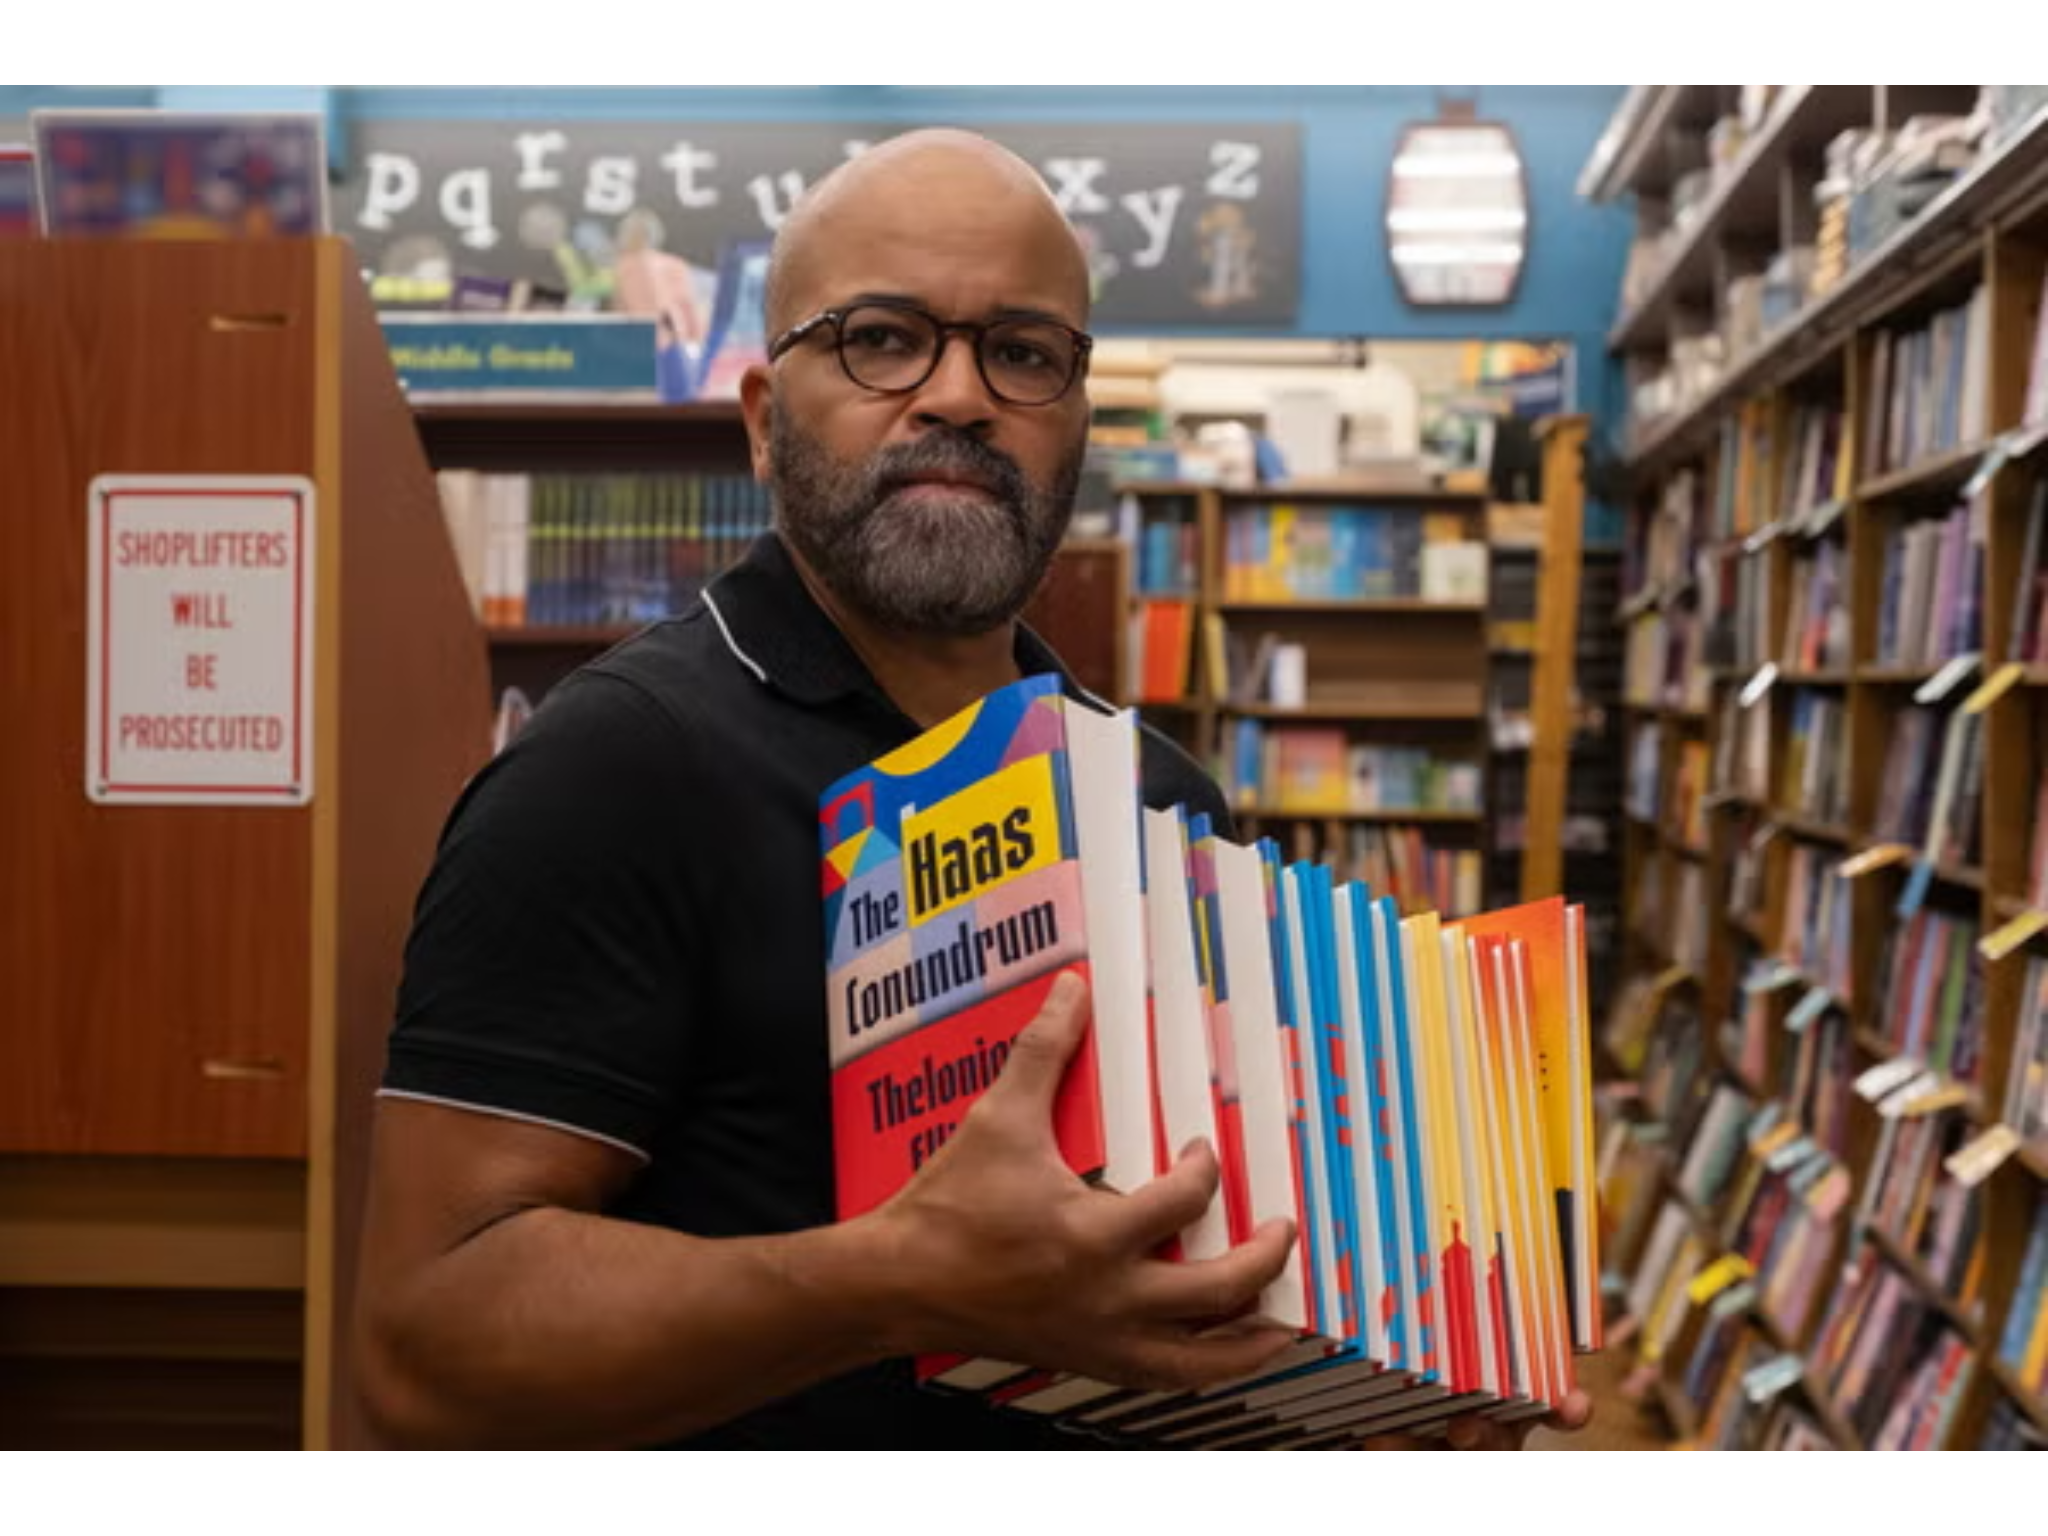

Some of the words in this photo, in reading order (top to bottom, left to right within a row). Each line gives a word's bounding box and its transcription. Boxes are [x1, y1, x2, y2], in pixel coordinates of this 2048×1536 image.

[357, 152, 420, 231] p
[439, 166, 499, 250] q
[513, 130, 567, 190] r
[583, 156, 637, 214] s
[660, 142, 717, 207] t
[1119, 184, 1184, 268] y
[117, 530, 287, 568] SHOPLIFTERS
[171, 594, 233, 628] WILL
[184, 654, 217, 690] BE
[118, 715, 284, 751] PROSECUTED
[849, 889, 900, 949] The
[910, 806, 1035, 917] Haas
[845, 900, 1059, 1036] Conundrum
